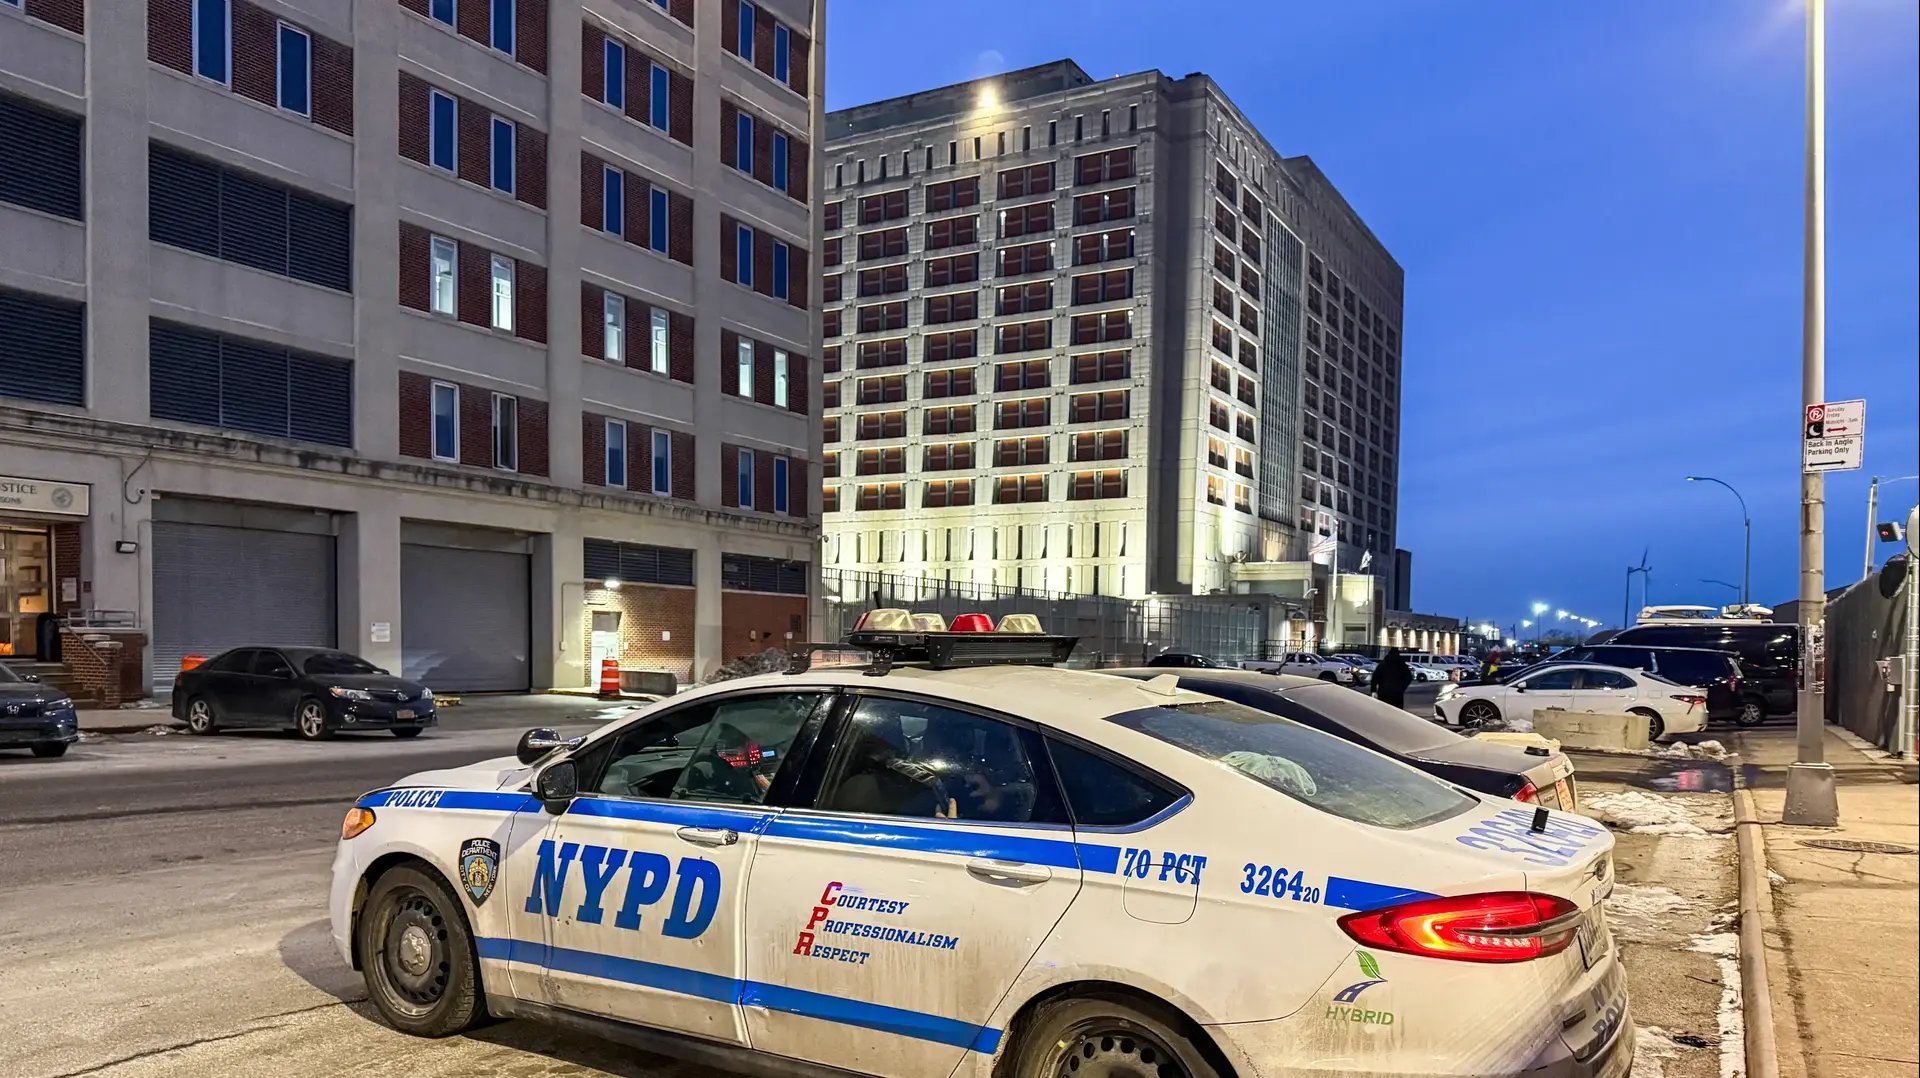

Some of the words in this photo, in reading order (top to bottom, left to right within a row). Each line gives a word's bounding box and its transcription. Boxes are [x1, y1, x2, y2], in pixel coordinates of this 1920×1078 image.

[1834, 438, 1853, 446] Angle
[1808, 448, 1833, 456] Parking
[1834, 446, 1849, 454] Only
[1, 482, 37, 495] STICE
[384, 790, 444, 808] POLICE
[471, 840, 491, 848] POLICE
[461, 846, 497, 860] DEPARTMENT
[1122, 847, 1151, 879] 70
[1158, 851, 1208, 886] PCT
[464, 884, 471, 892] OF
[484, 883, 492, 897] NEW
[524, 839, 722, 940] NYPD
[820, 881, 909, 915] COURTESY
[806, 906, 959, 950] PROFESSIONALISM
[793, 931, 870, 965] RESPECT
[1325, 1006, 1395, 1026] HYBRID
